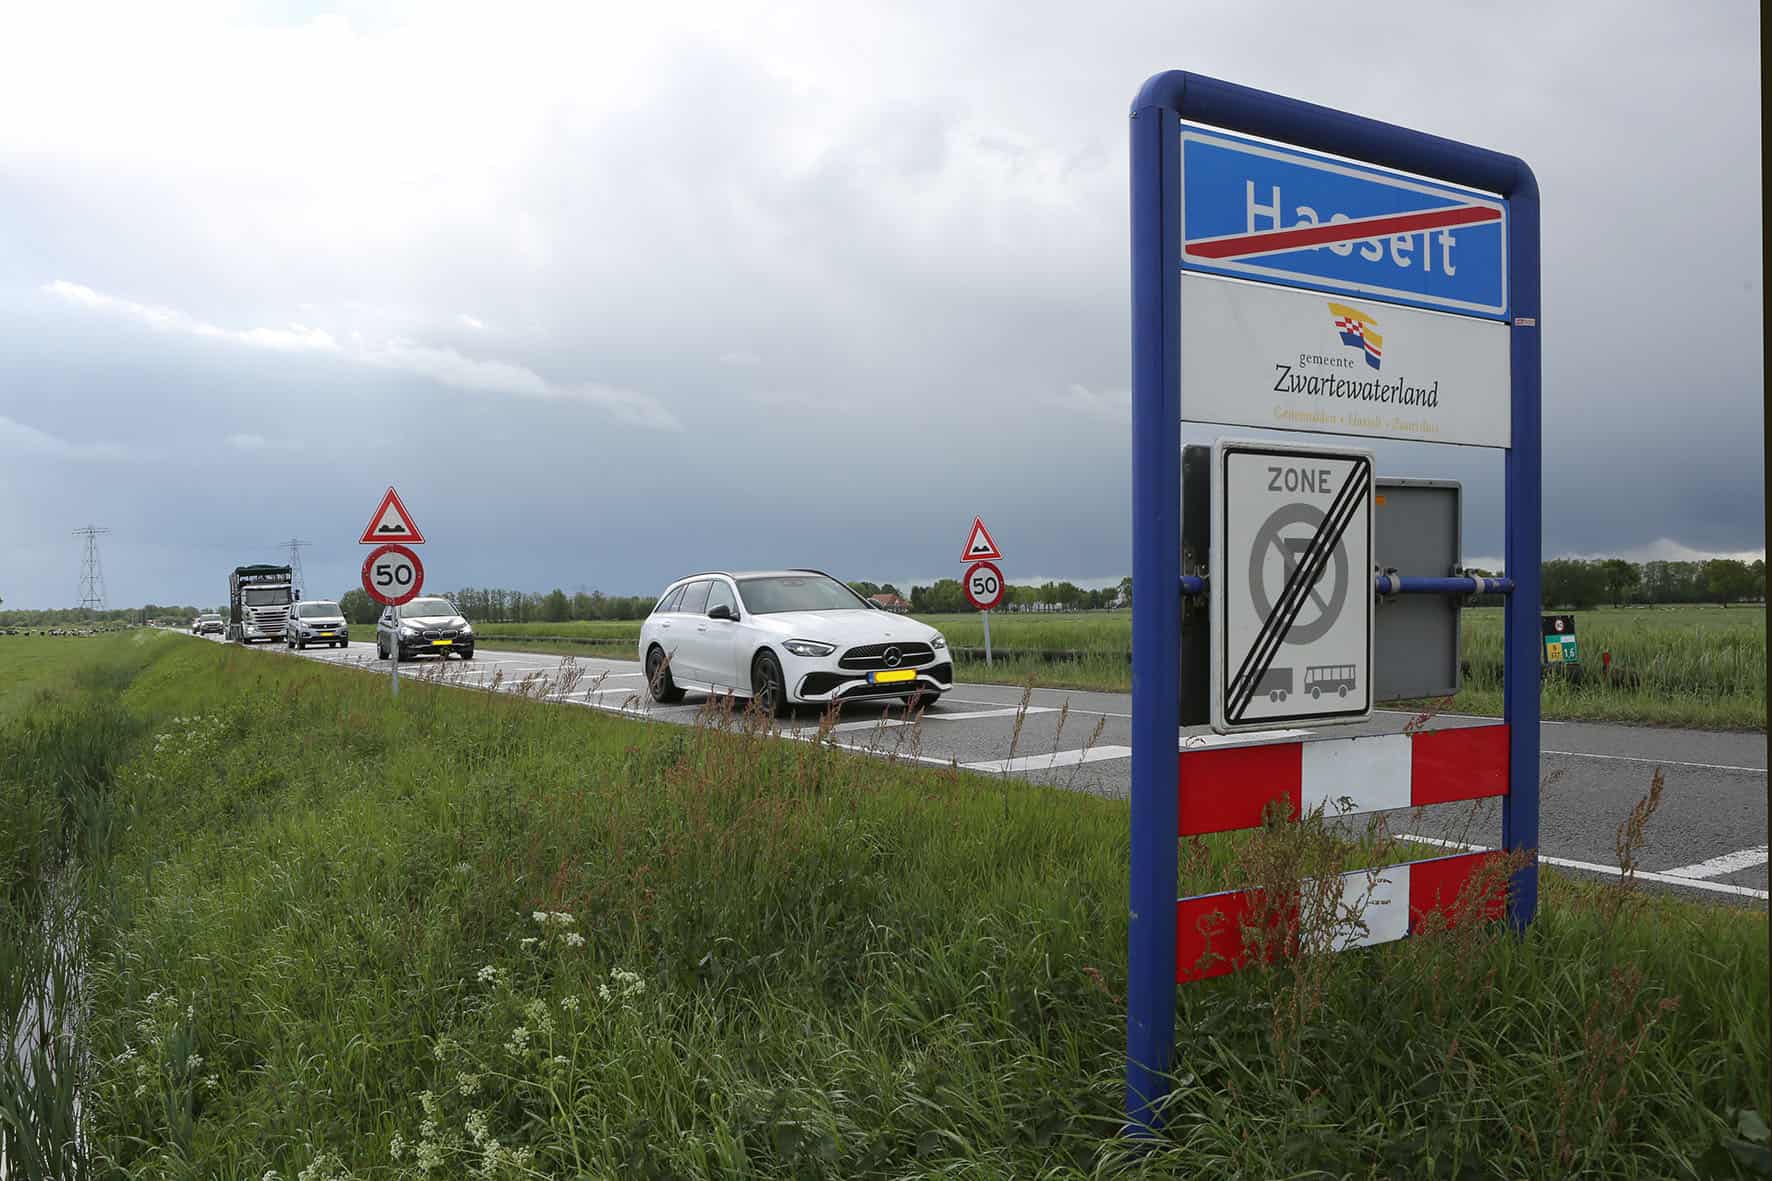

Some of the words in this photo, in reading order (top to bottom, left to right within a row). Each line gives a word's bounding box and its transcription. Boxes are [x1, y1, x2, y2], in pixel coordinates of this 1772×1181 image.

[1299, 353, 1355, 368] gemeente
[1273, 363, 1439, 408] Zwartewaterland
[1268, 467, 1331, 494] ZONE
[376, 564, 412, 586] 50
[973, 576, 997, 595] 50
